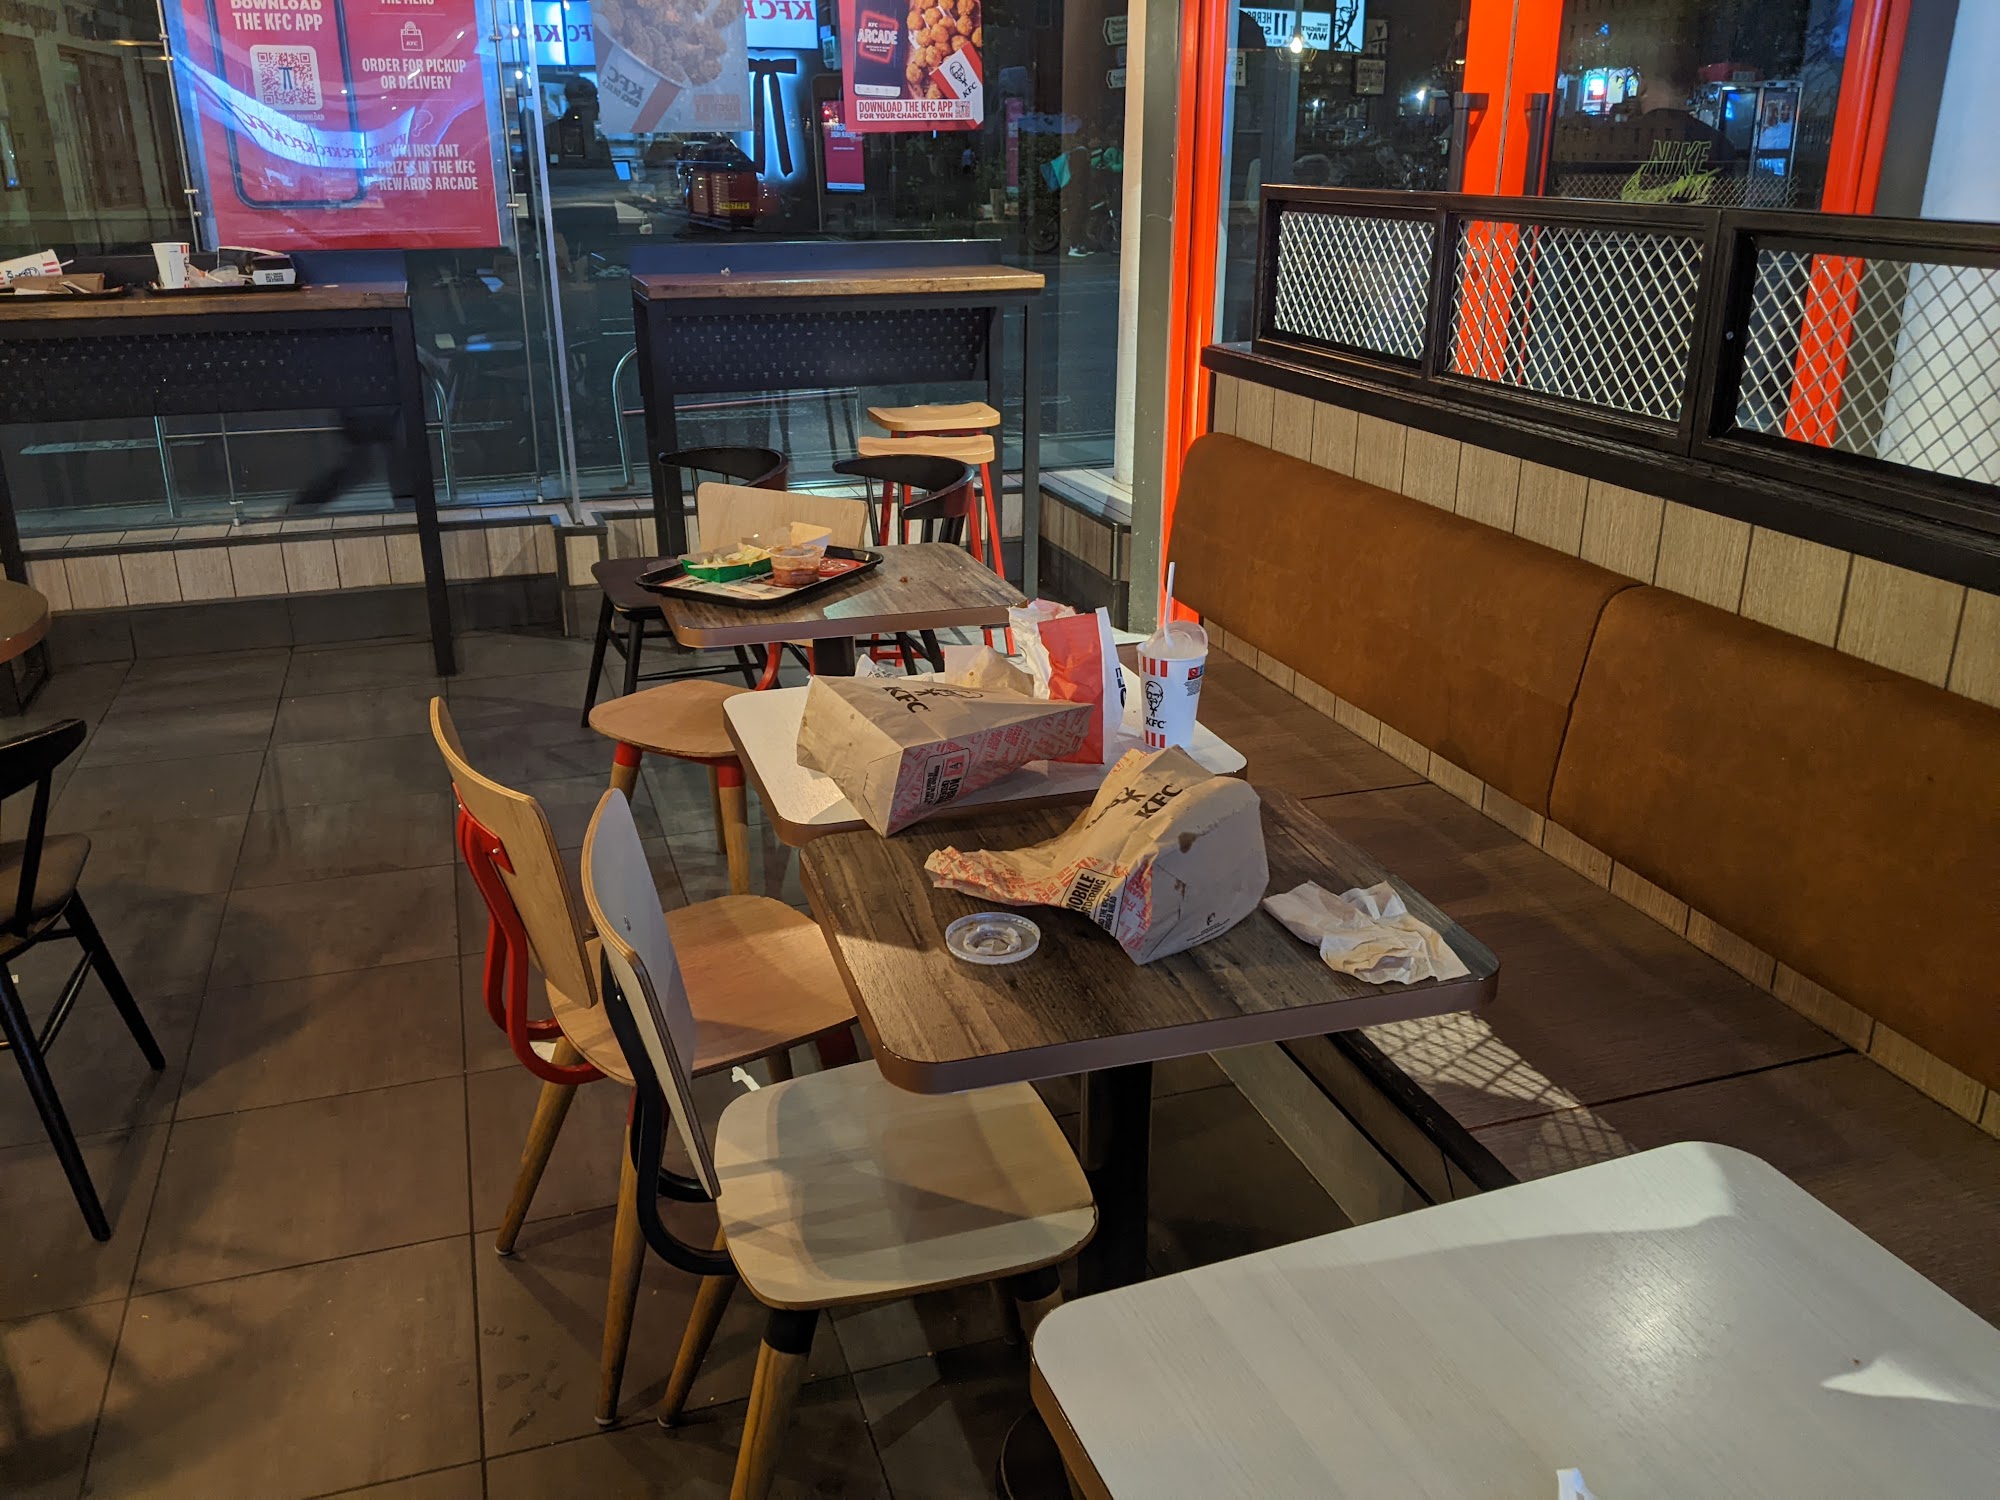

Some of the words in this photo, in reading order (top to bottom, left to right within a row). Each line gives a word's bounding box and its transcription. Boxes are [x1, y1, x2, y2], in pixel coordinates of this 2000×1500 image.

[231, 0, 322, 10] DOWNLOAD
[233, 13, 262, 31] THE
[264, 13, 292, 31] KFC
[296, 13, 323, 32] APP
[857, 29, 898, 45] ARCADE
[362, 58, 399, 72] ORDER
[402, 59, 423, 73] FOR
[426, 59, 466, 74] PICKUP
[381, 76, 397, 89] OR
[399, 76, 452, 90] DELIVERY
[962, 82, 978, 98] KFC
[859, 101, 902, 112] DOWNLOAD
[905, 101, 919, 112] THE
[921, 101, 936, 112] KFC
[937, 101, 953, 112] APP
[413, 144, 459, 157] INSTANT
[1643, 139, 1712, 178] NIKE
[378, 161, 416, 175] PRIZES
[418, 161, 430, 174] IN
[432, 161, 453, 174] THE
[455, 160, 476, 174] KFC
[379, 177, 433, 191] REWARDS
[435, 176, 478, 190] ARCADE
[882, 686, 929, 714] KFC
[1145, 716, 1166, 729] KFC
[1134, 783, 1183, 820] KFC
[1081, 879, 1107, 915] RDERING
